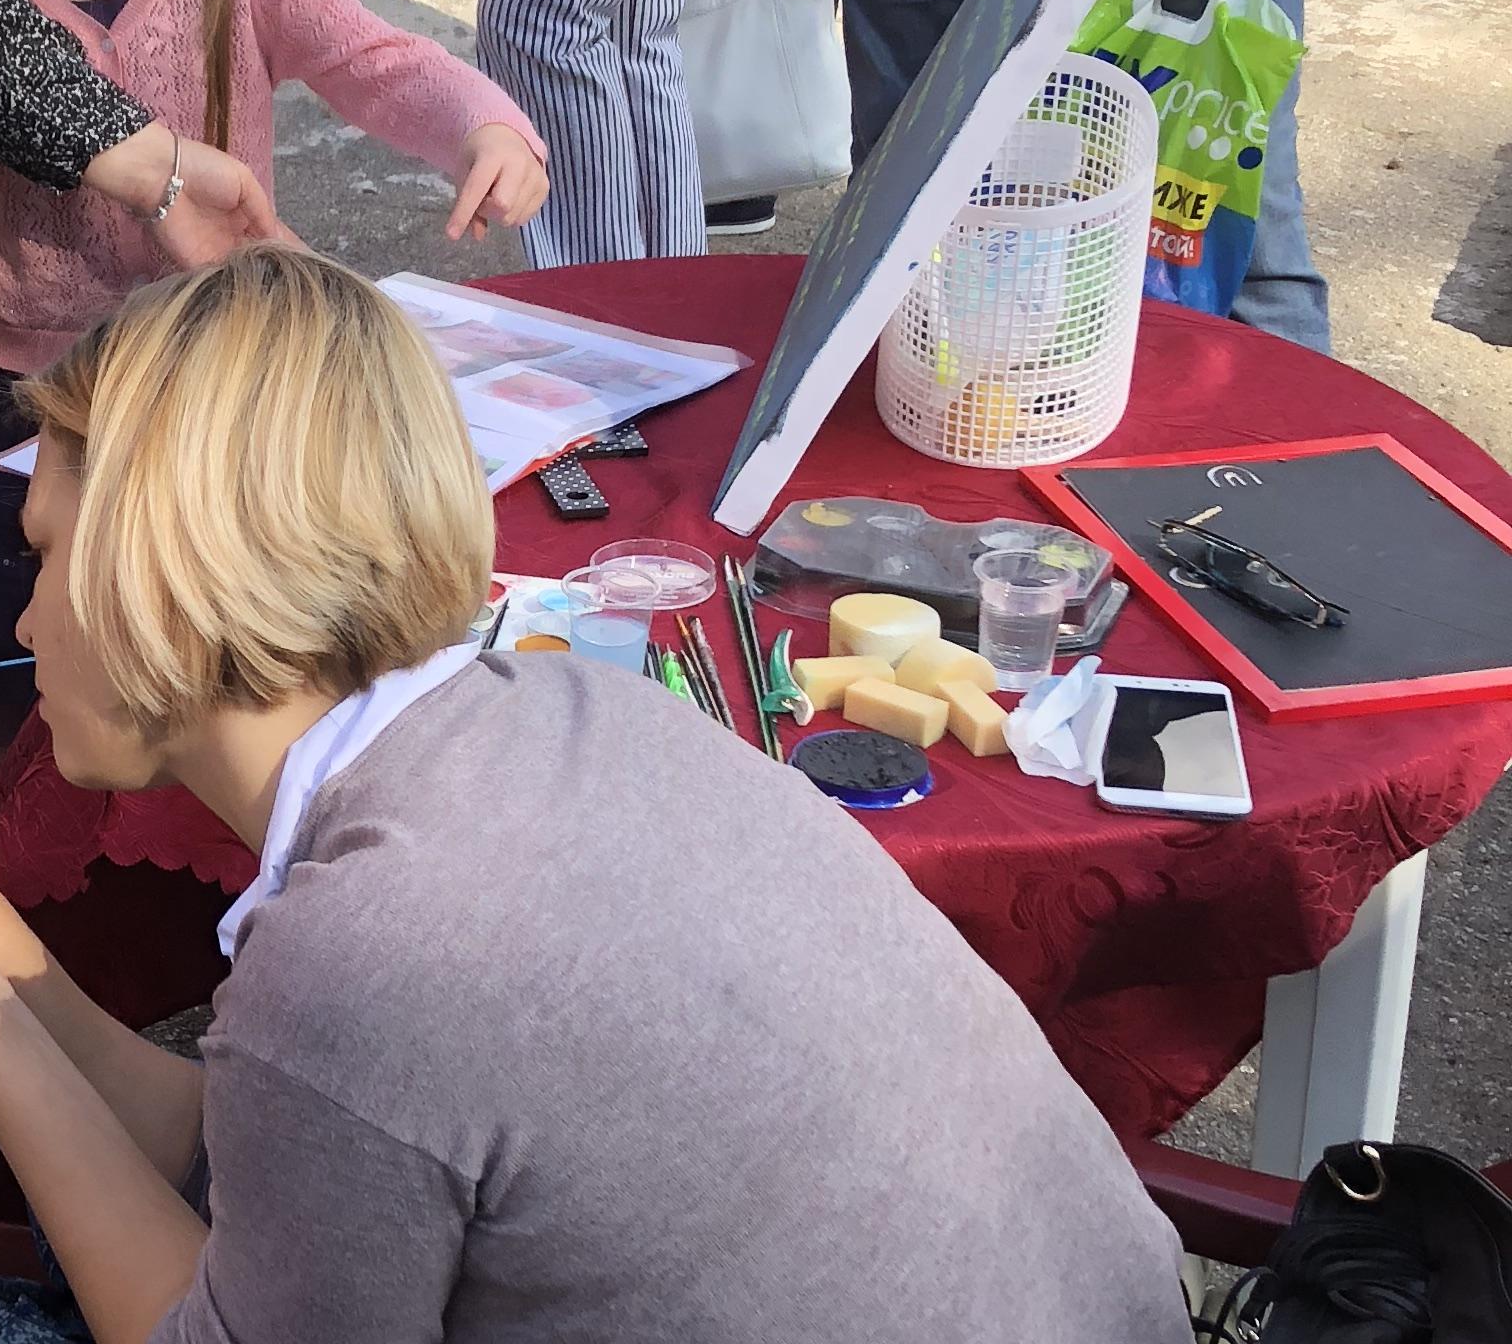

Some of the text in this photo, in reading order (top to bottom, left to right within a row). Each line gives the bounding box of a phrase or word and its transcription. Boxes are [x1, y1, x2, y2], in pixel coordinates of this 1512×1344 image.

[1160, 81, 1269, 144] price
[1153, 181, 1208, 220] ИЖЕ
[1151, 226, 1194, 258] ТОЙ!
